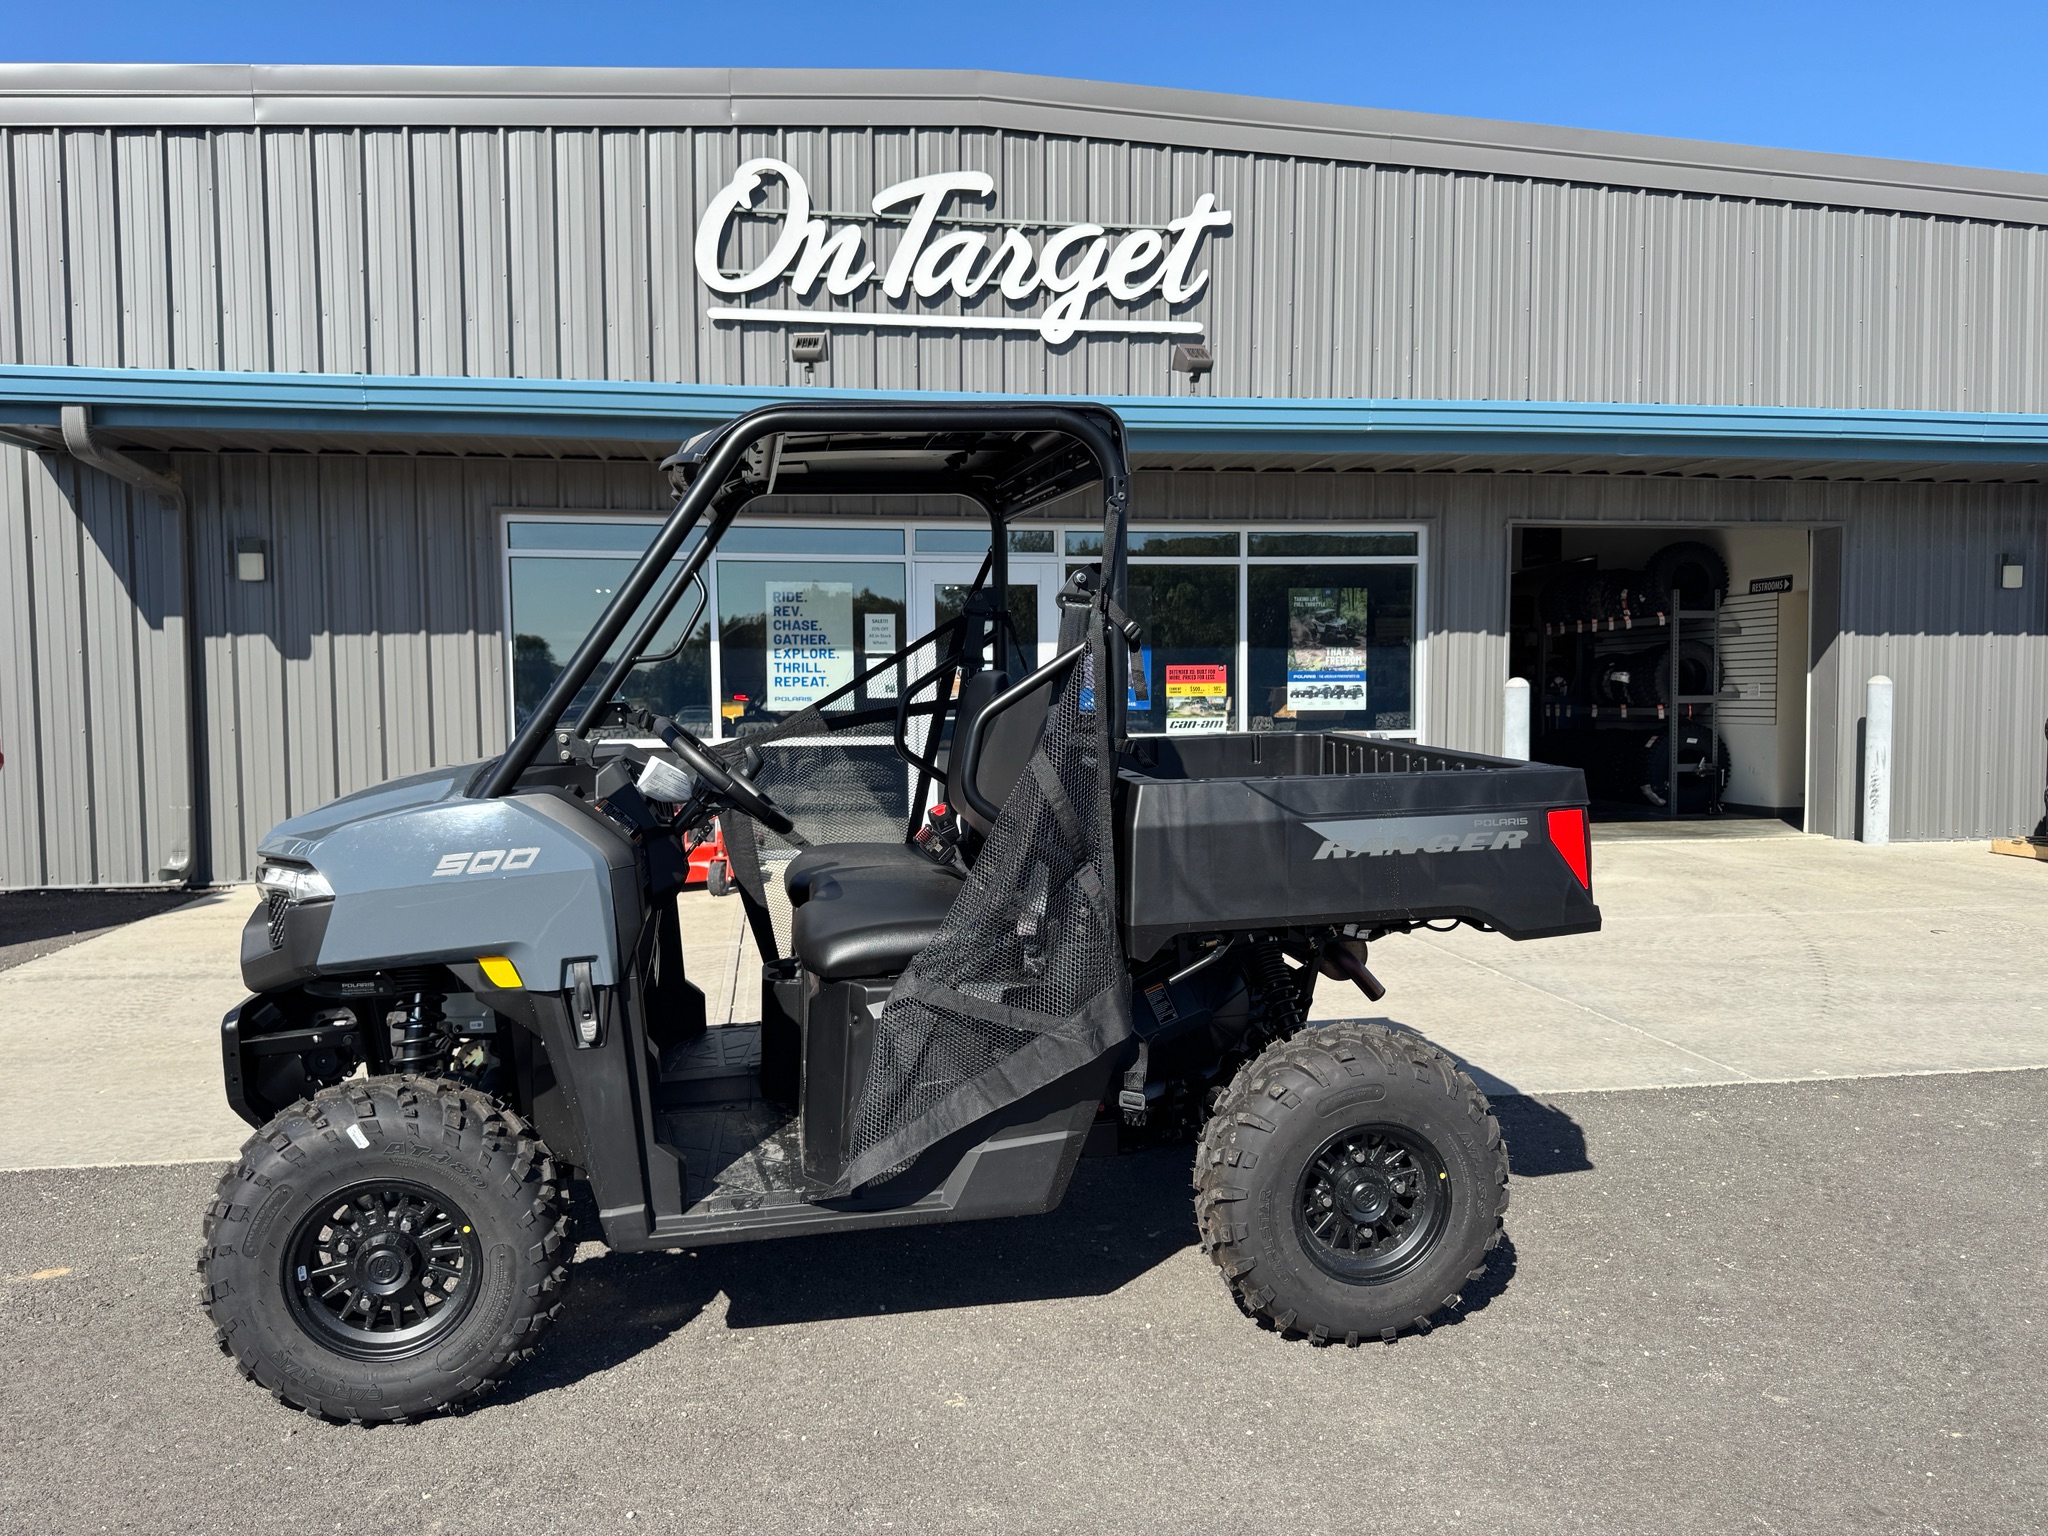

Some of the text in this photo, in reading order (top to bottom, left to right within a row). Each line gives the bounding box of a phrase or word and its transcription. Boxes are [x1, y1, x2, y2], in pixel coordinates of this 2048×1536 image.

[695, 158, 1232, 344] On Target
[1751, 580, 1783, 592] RESTROOMS
[773, 591, 807, 603] RIDE.
[773, 605, 803, 617] REV.
[773, 620, 822, 631] CHASE.
[773, 634, 830, 645] GATHER.
[774, 648, 839, 659] EXPLORE.
[1325, 646, 1354, 656] THAT'S
[1325, 656, 1362, 666] FREEDOM
[774, 662, 826, 673] THRILL.
[774, 676, 829, 687] REPEAT.
[1169, 720, 1224, 729] can-am
[1474, 817, 1529, 828] POLARIS
[1311, 830, 1529, 861] RANGER
[431, 847, 541, 877] 500
[383, 1141, 488, 1190] AT489
